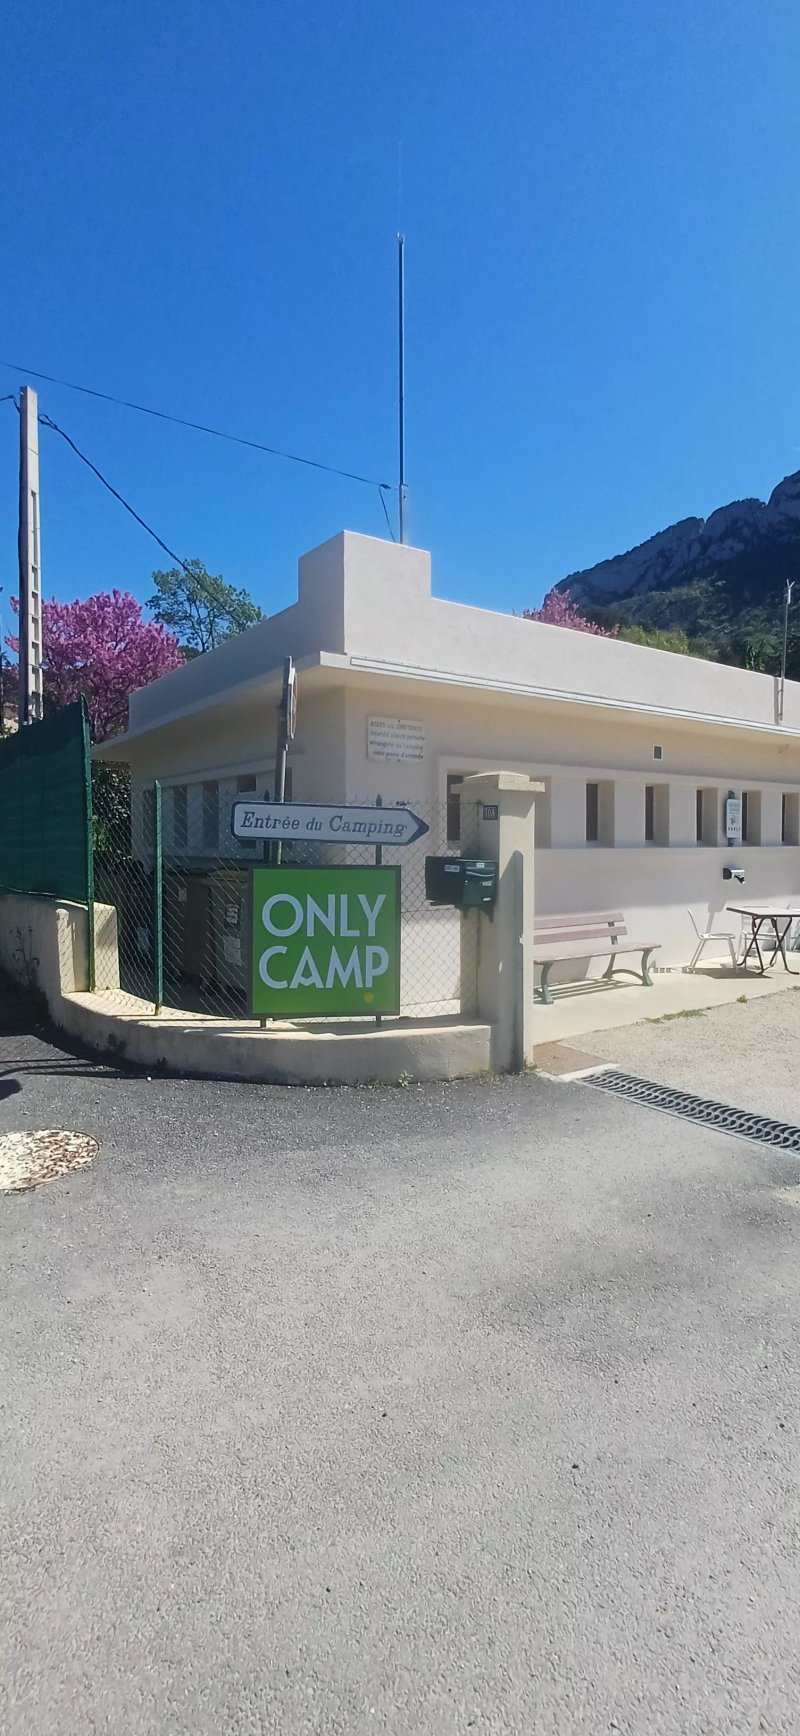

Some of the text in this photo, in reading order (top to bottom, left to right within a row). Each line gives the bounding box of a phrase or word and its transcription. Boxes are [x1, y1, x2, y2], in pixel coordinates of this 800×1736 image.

[240, 811, 407, 837] Entrée du Camping
[262, 893, 387, 937] ONLY
[259, 945, 389, 989] CAMP
